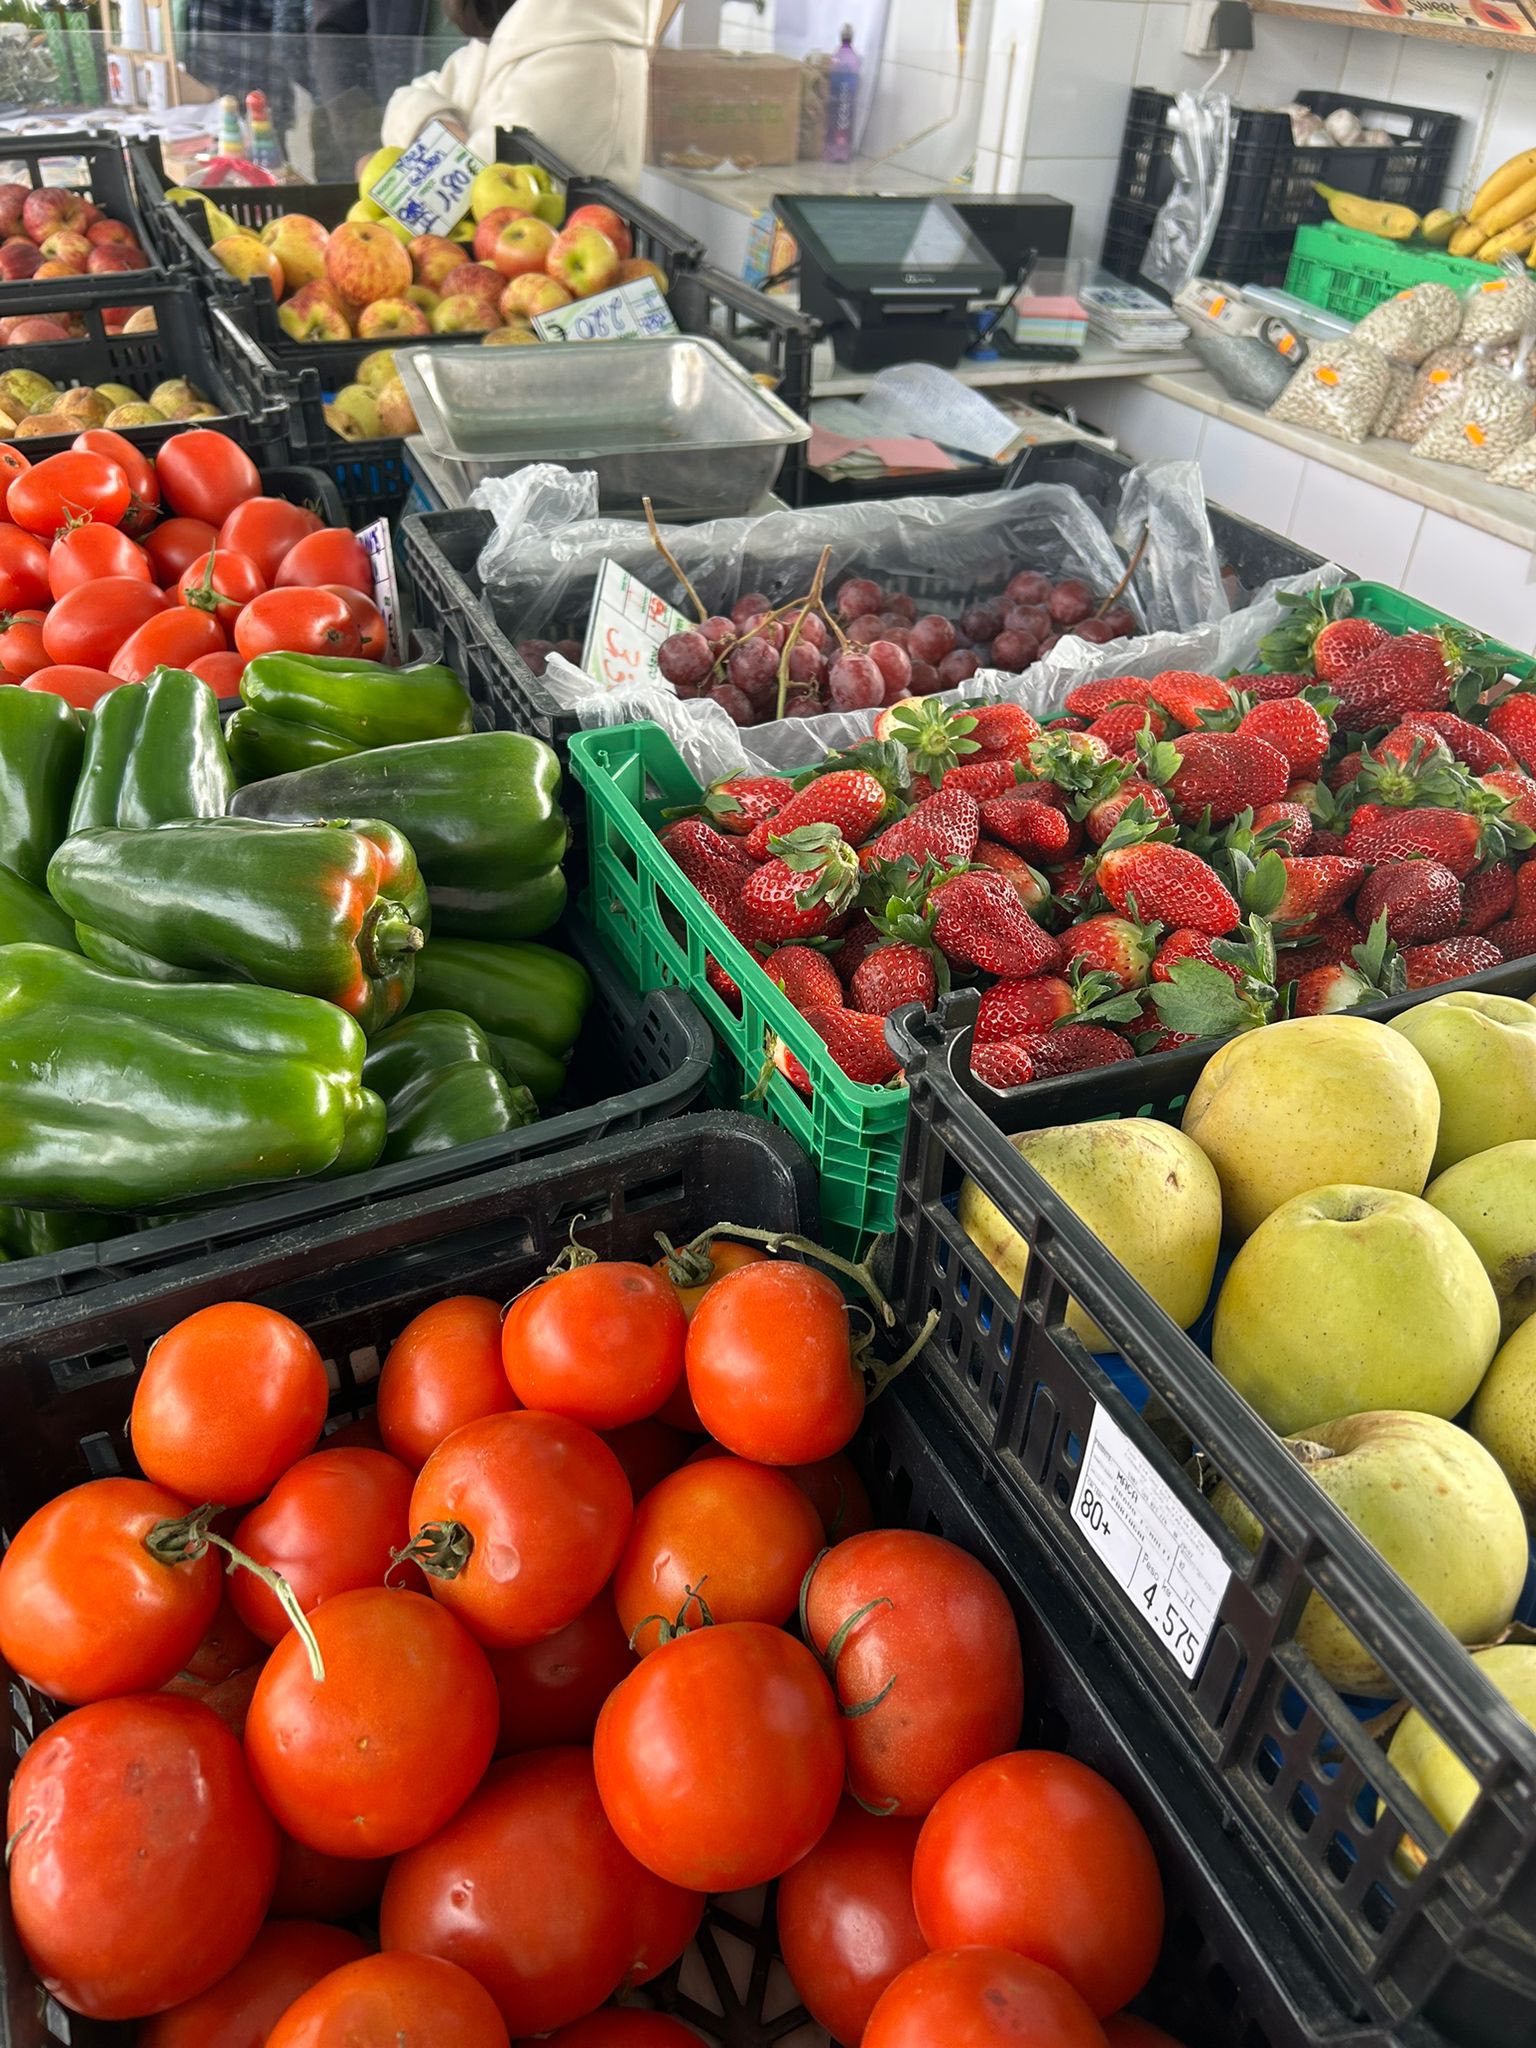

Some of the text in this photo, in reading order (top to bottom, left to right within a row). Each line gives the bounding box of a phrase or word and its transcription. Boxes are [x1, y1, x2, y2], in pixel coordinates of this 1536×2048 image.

[1407, 0, 1460, 15] Sweet
[1080, 1488, 1111, 1536] 80+
[1142, 1552, 1160, 1581] Peso
[1143, 1583, 1200, 1665] 4.575
